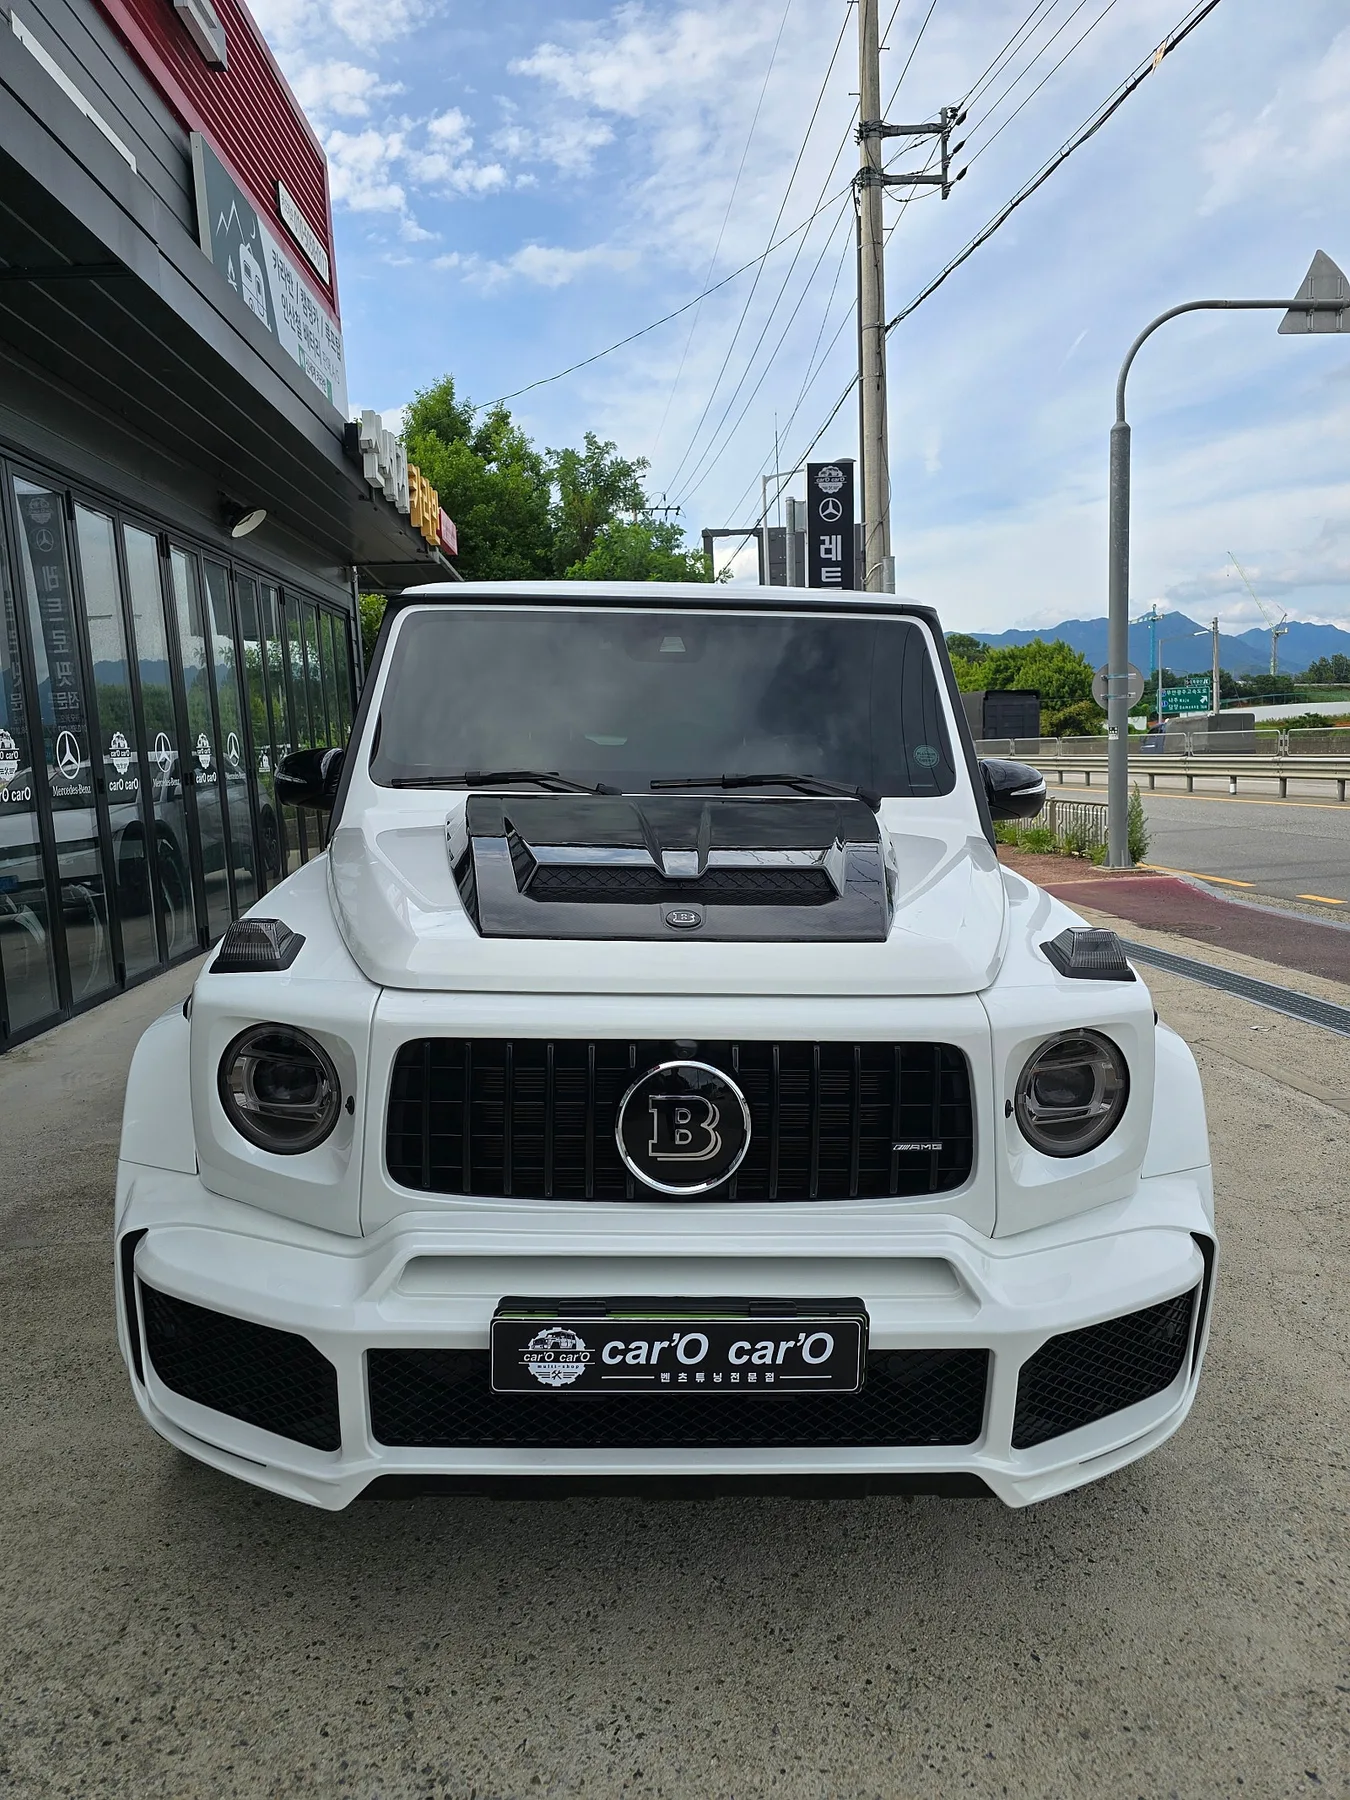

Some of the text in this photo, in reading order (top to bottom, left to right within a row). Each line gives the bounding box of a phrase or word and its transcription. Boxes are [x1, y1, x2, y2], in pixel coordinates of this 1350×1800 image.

[271, 249, 294, 299] 카라반
[52, 784, 92, 797] Mercedes-Benz
[649, 1095, 722, 1161] B
[601, 1331, 835, 1366] car'O car'O
[660, 1372, 775, 1383] 벤츠튜닝전문점
